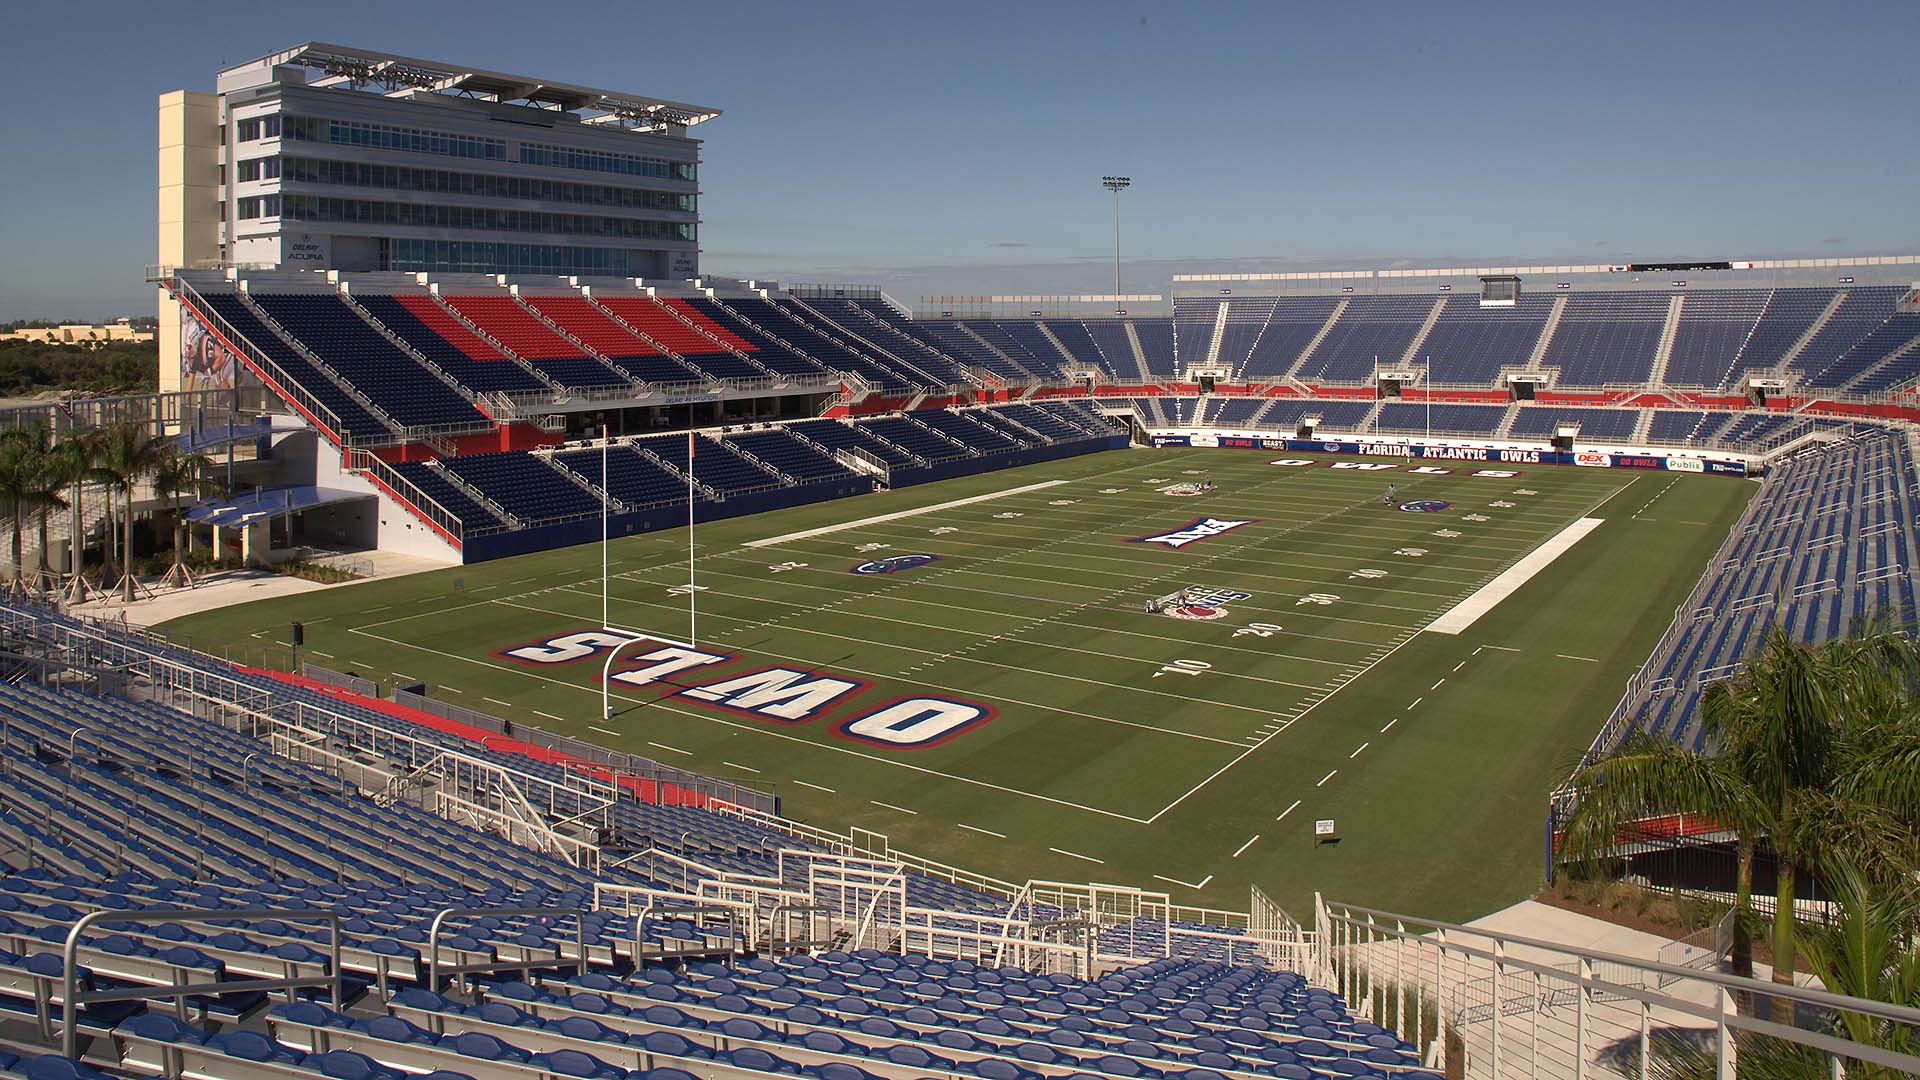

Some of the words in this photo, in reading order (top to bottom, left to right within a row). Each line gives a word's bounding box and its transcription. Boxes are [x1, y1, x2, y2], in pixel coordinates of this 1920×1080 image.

[1358, 444, 1408, 457] FLORIDA
[1422, 447, 1487, 460] ATLANTIC
[1500, 450, 1540, 463] OWLS
[1669, 461, 1700, 470] Publix
[1236, 623, 1283, 638] 20
[1161, 660, 1212, 676] 10
[504, 632, 981, 744] OWLS
